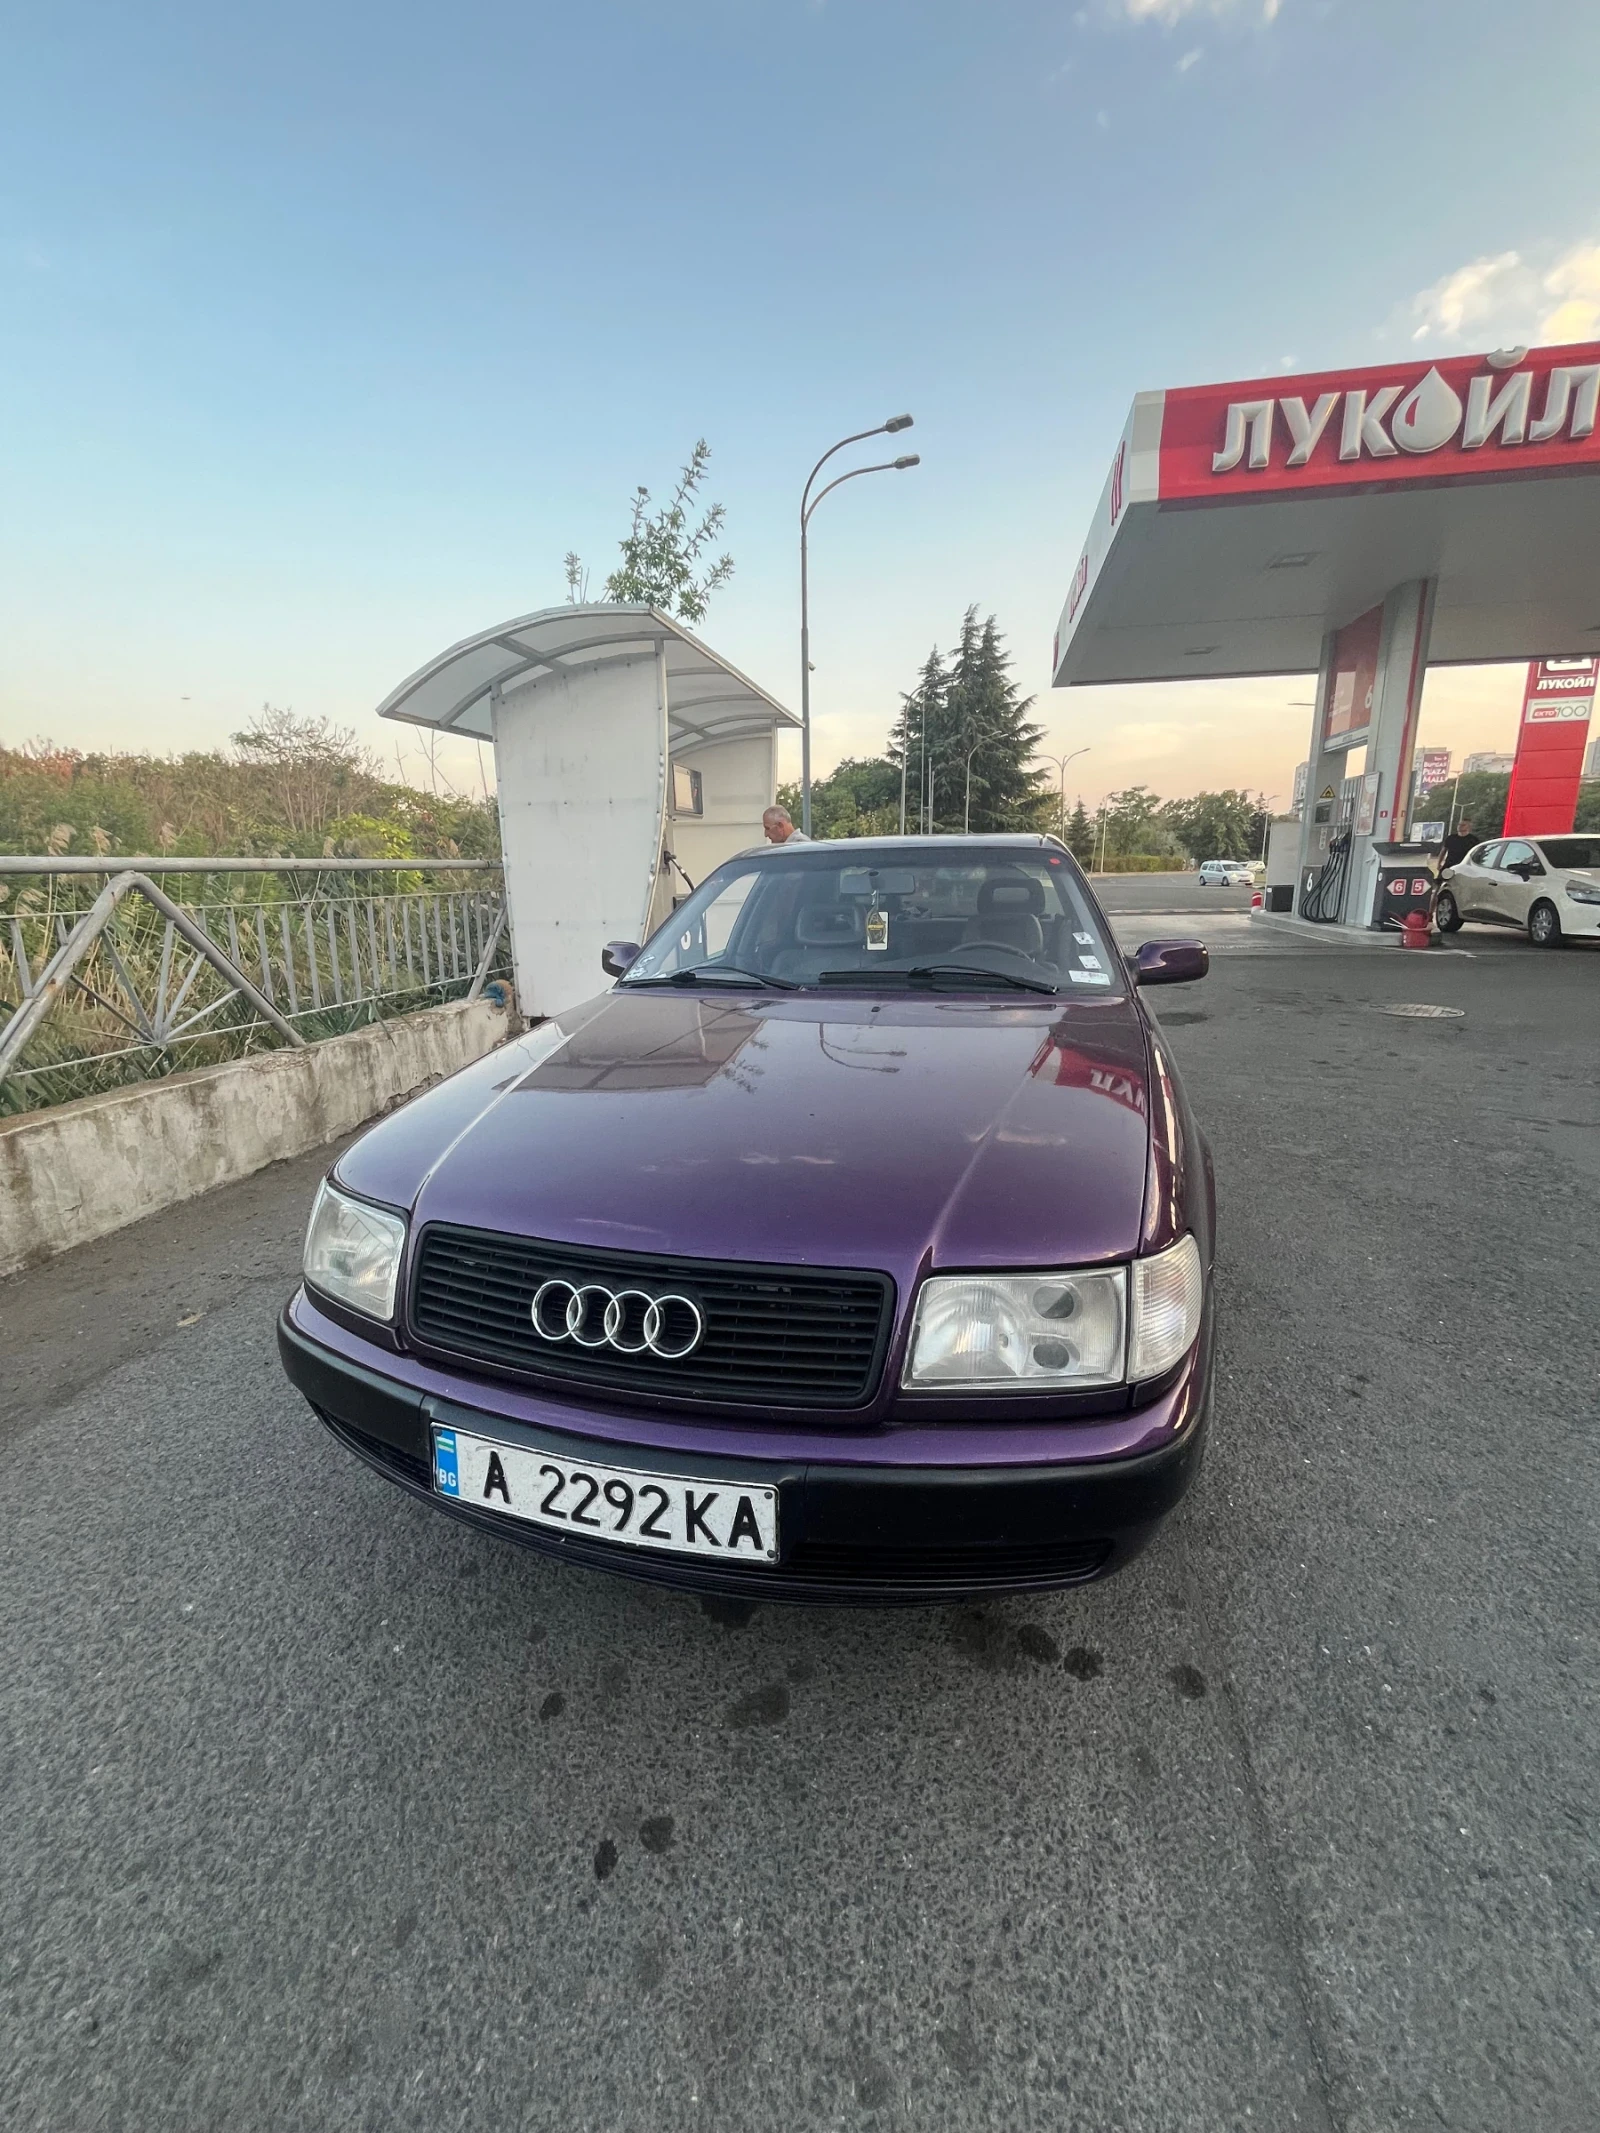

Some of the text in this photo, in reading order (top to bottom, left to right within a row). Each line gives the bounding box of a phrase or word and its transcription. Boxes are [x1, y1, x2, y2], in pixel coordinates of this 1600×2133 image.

[1537, 676, 1595, 691] ЛУКОЙЛ
[1555, 705, 1587, 718] 100
[1422, 775, 1446, 783] MALL
[1306, 872, 1313, 892] 6
[1394, 883, 1404, 893] 6
[1414, 882, 1423, 892] 5
[438, 1468, 457, 1487] BG
[483, 1450, 764, 1551] A 2292 KA
